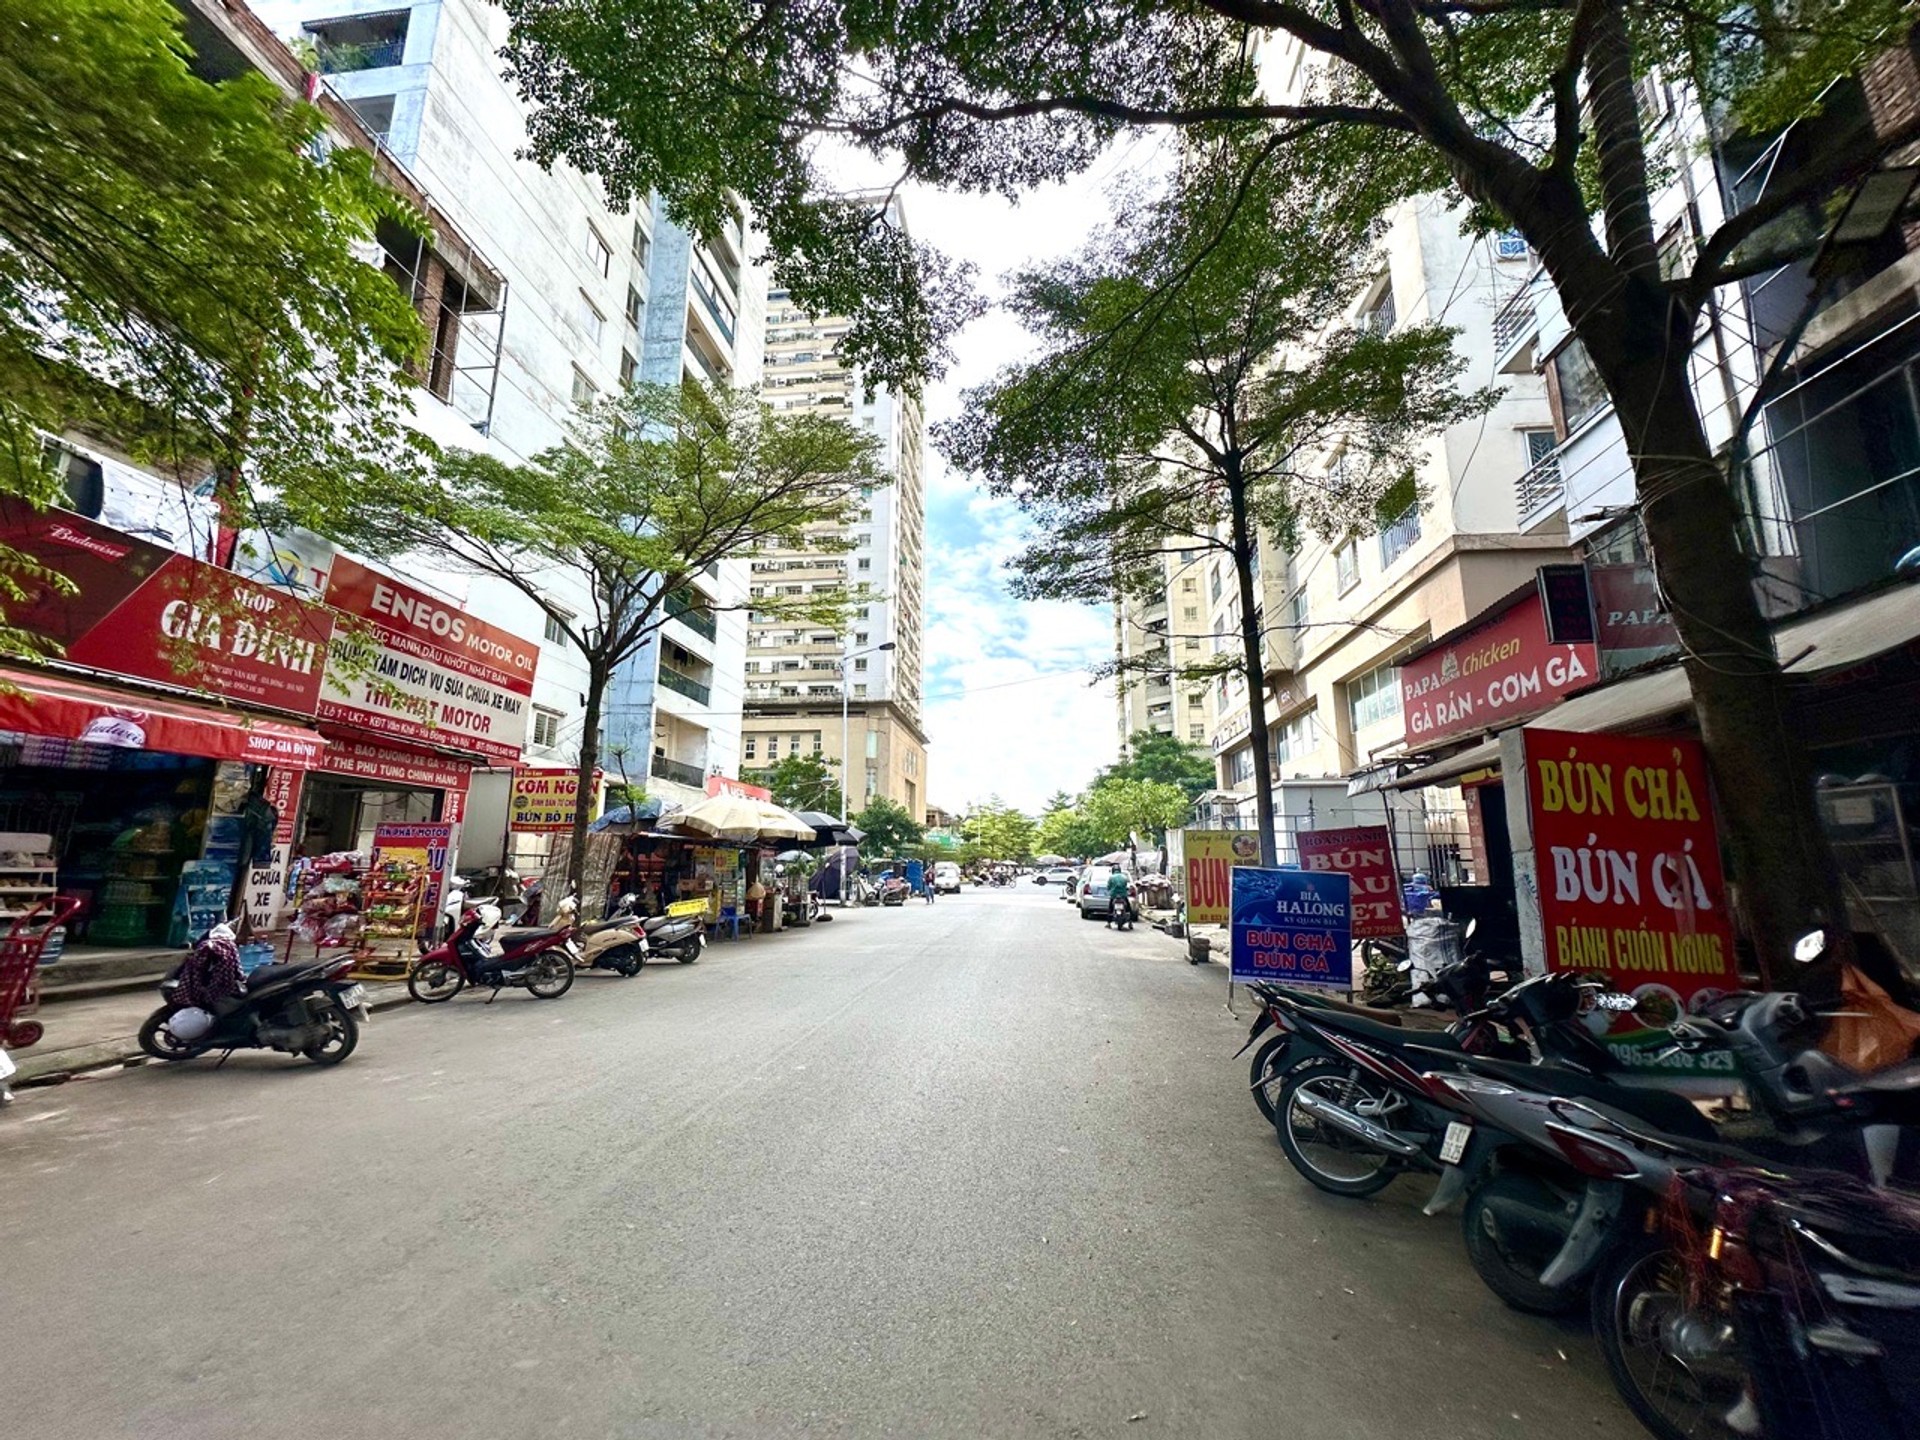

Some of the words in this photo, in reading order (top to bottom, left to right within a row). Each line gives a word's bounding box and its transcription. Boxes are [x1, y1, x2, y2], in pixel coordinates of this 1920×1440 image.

[50, 524, 125, 558] Budweiser
[234, 587, 275, 614] SHOP
[161, 599, 221, 650] GIA
[371, 583, 467, 642] ENEOS
[466, 634, 514, 662] MOTOR
[516, 654, 533, 672] OIL
[1405, 673, 1441, 701] PAPA
[1462, 637, 1520, 676] Chicken
[400, 662, 428, 686] DỊCH
[430, 672, 444, 694] VỤ
[490, 692, 504, 710] XE
[1412, 702, 1434, 734] GÀ
[1436, 690, 1473, 726] RÁN
[1488, 666, 1542, 708] CƠM
[1546, 643, 1588, 688] GÀ
[441, 704, 492, 734] MOTOR
[248, 736, 276, 750] SHOP
[276, 740, 292, 752] GIA
[413, 755, 426, 766] XE
[428, 758, 439, 768] GA
[554, 780, 599, 794] NGN
[1538, 747, 1614, 816] BÚN
[1624, 747, 1700, 822] CHẢ
[450, 793, 460, 823] ENEO
[516, 810, 542, 822] BÚN
[546, 810, 562, 822] BÒ
[418, 826, 448, 838] MOTOR
[1306, 847, 1386, 870] BÚN
[1550, 833, 1640, 906] BÚN
[1652, 838, 1712, 910] CÁ
[1189, 847, 1230, 908] BÚN
[254, 892, 271, 907] XE
[1300, 891, 1320, 902] BIA
[1351, 901, 1393, 926] ẸT
[1246, 926, 1288, 949] BÚN
[1293, 930, 1337, 952] CHẢ
[1556, 918, 1611, 969] BÁNH
[1614, 916, 1668, 972] CUỐN
[1254, 948, 1296, 970] BÚN
